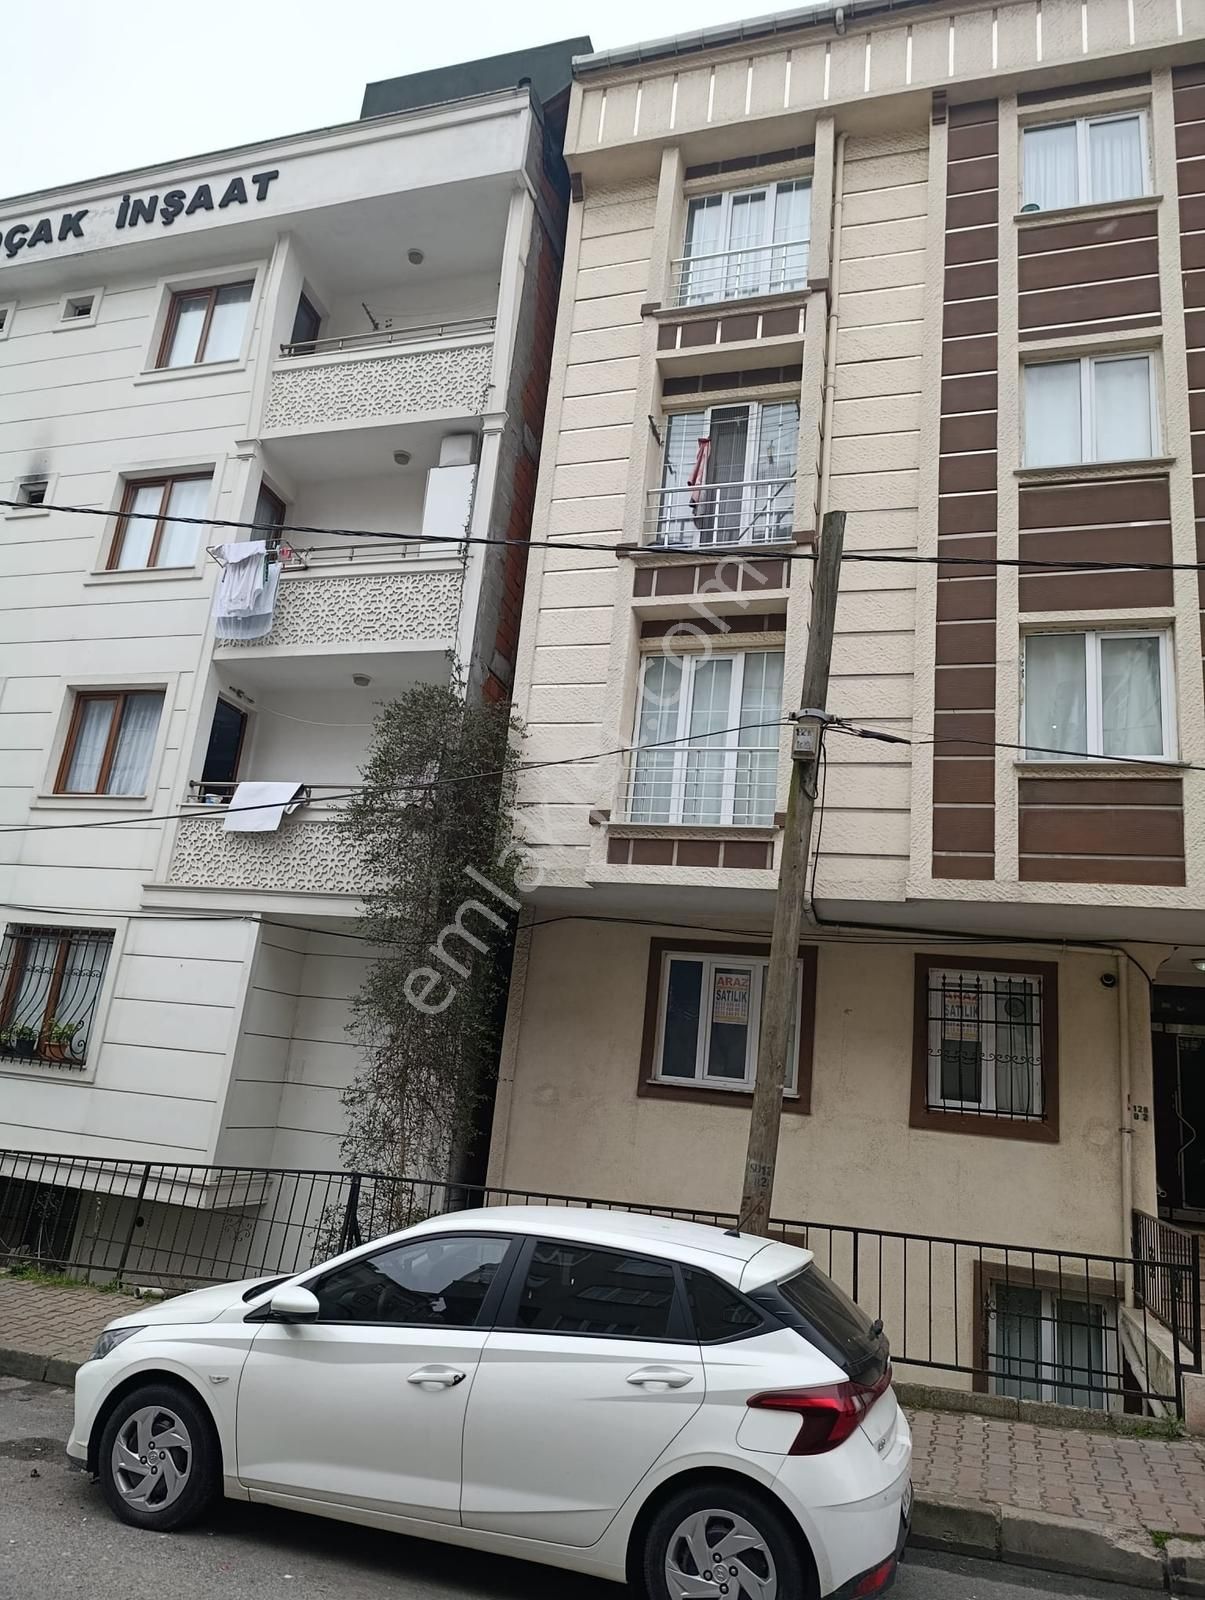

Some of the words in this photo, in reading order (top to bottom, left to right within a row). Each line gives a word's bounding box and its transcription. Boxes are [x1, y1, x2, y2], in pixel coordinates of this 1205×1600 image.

[0, 209, 89, 258] ÇAK
[115, 169, 279, 229] İNŞAAT
[717, 975, 749, 987] ARAZ
[715, 989, 748, 1003] SATILIK
